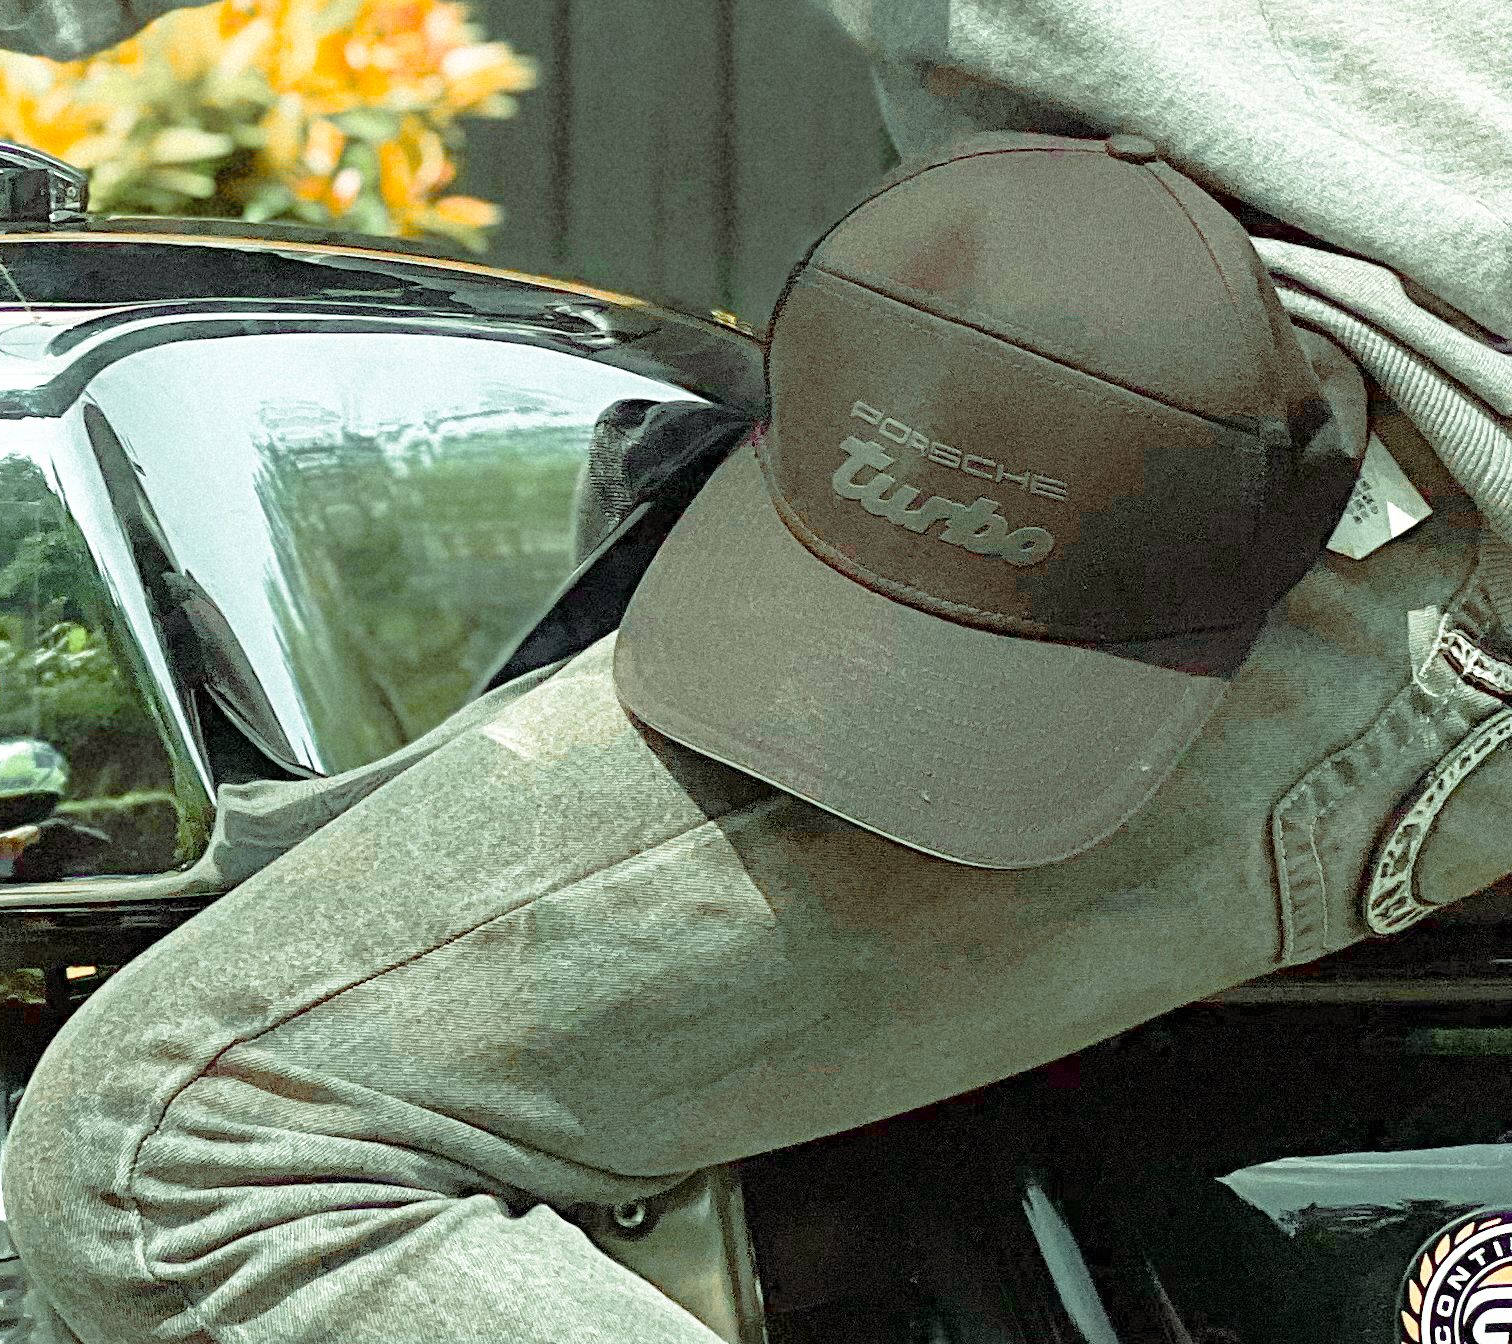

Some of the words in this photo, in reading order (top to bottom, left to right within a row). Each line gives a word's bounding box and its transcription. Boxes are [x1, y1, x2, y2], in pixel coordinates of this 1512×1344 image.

[831, 434, 1056, 567] turbo
[849, 400, 1069, 502] PORSCHE
[1434, 1235, 1512, 1344] CONTI
